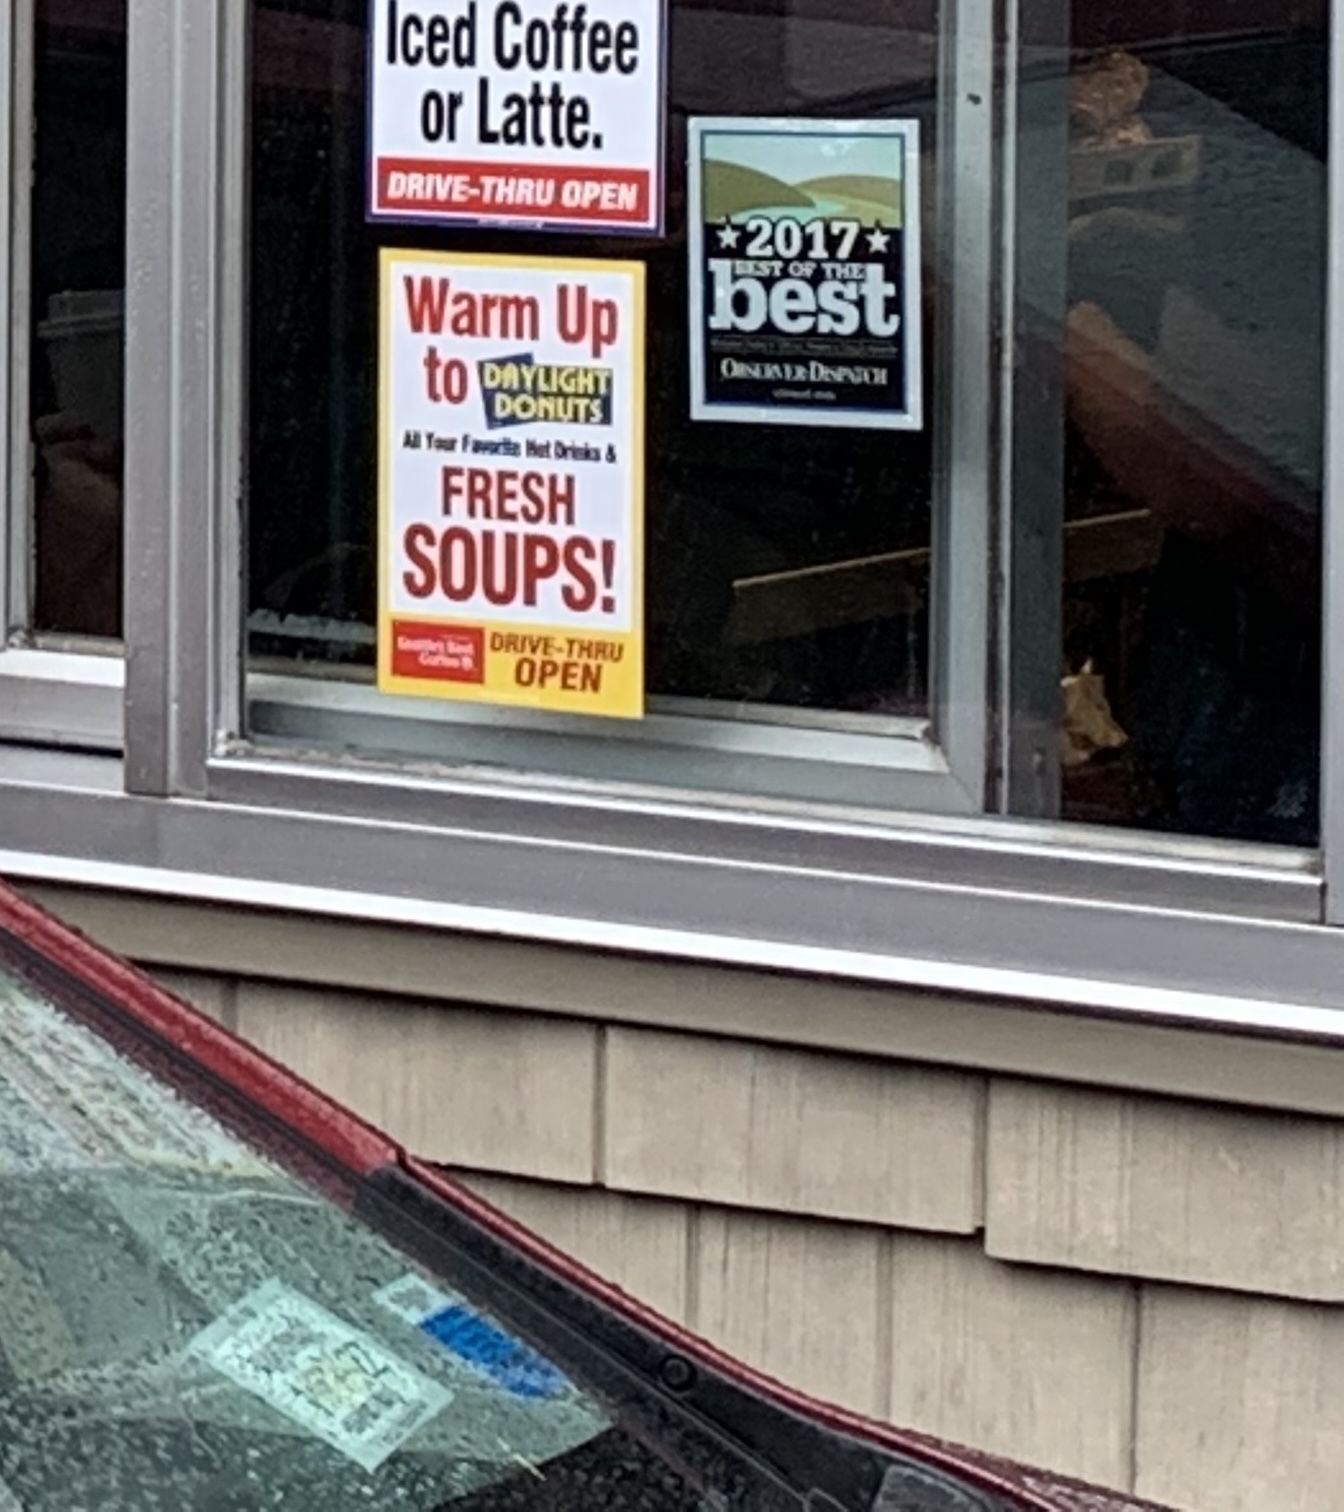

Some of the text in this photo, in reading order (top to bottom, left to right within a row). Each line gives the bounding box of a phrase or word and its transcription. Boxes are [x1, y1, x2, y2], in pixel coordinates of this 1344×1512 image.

[493, 0, 639, 75] Coffee
[420, 76, 603, 150] or Latte.
[387, 171, 639, 211] DRIVE-THRU OPEN
[745, 218, 861, 259] 2017
[735, 260, 865, 280] BEST OF THE
[402, 274, 618, 358] Warm Up
[708, 258, 901, 337] best
[423, 346, 469, 404] to
[483, 361, 610, 396] DAYLIGHT
[493, 392, 604, 424] DONUTS
[403, 430, 422, 449] All
[426, 432, 458, 453] Your
[554, 439, 602, 462] Drinks
[441, 465, 575, 526] FRESH
[402, 523, 617, 615] SOUPS!
[489, 631, 625, 664] DRIVE-THRU
[514, 657, 604, 693] OPEN
